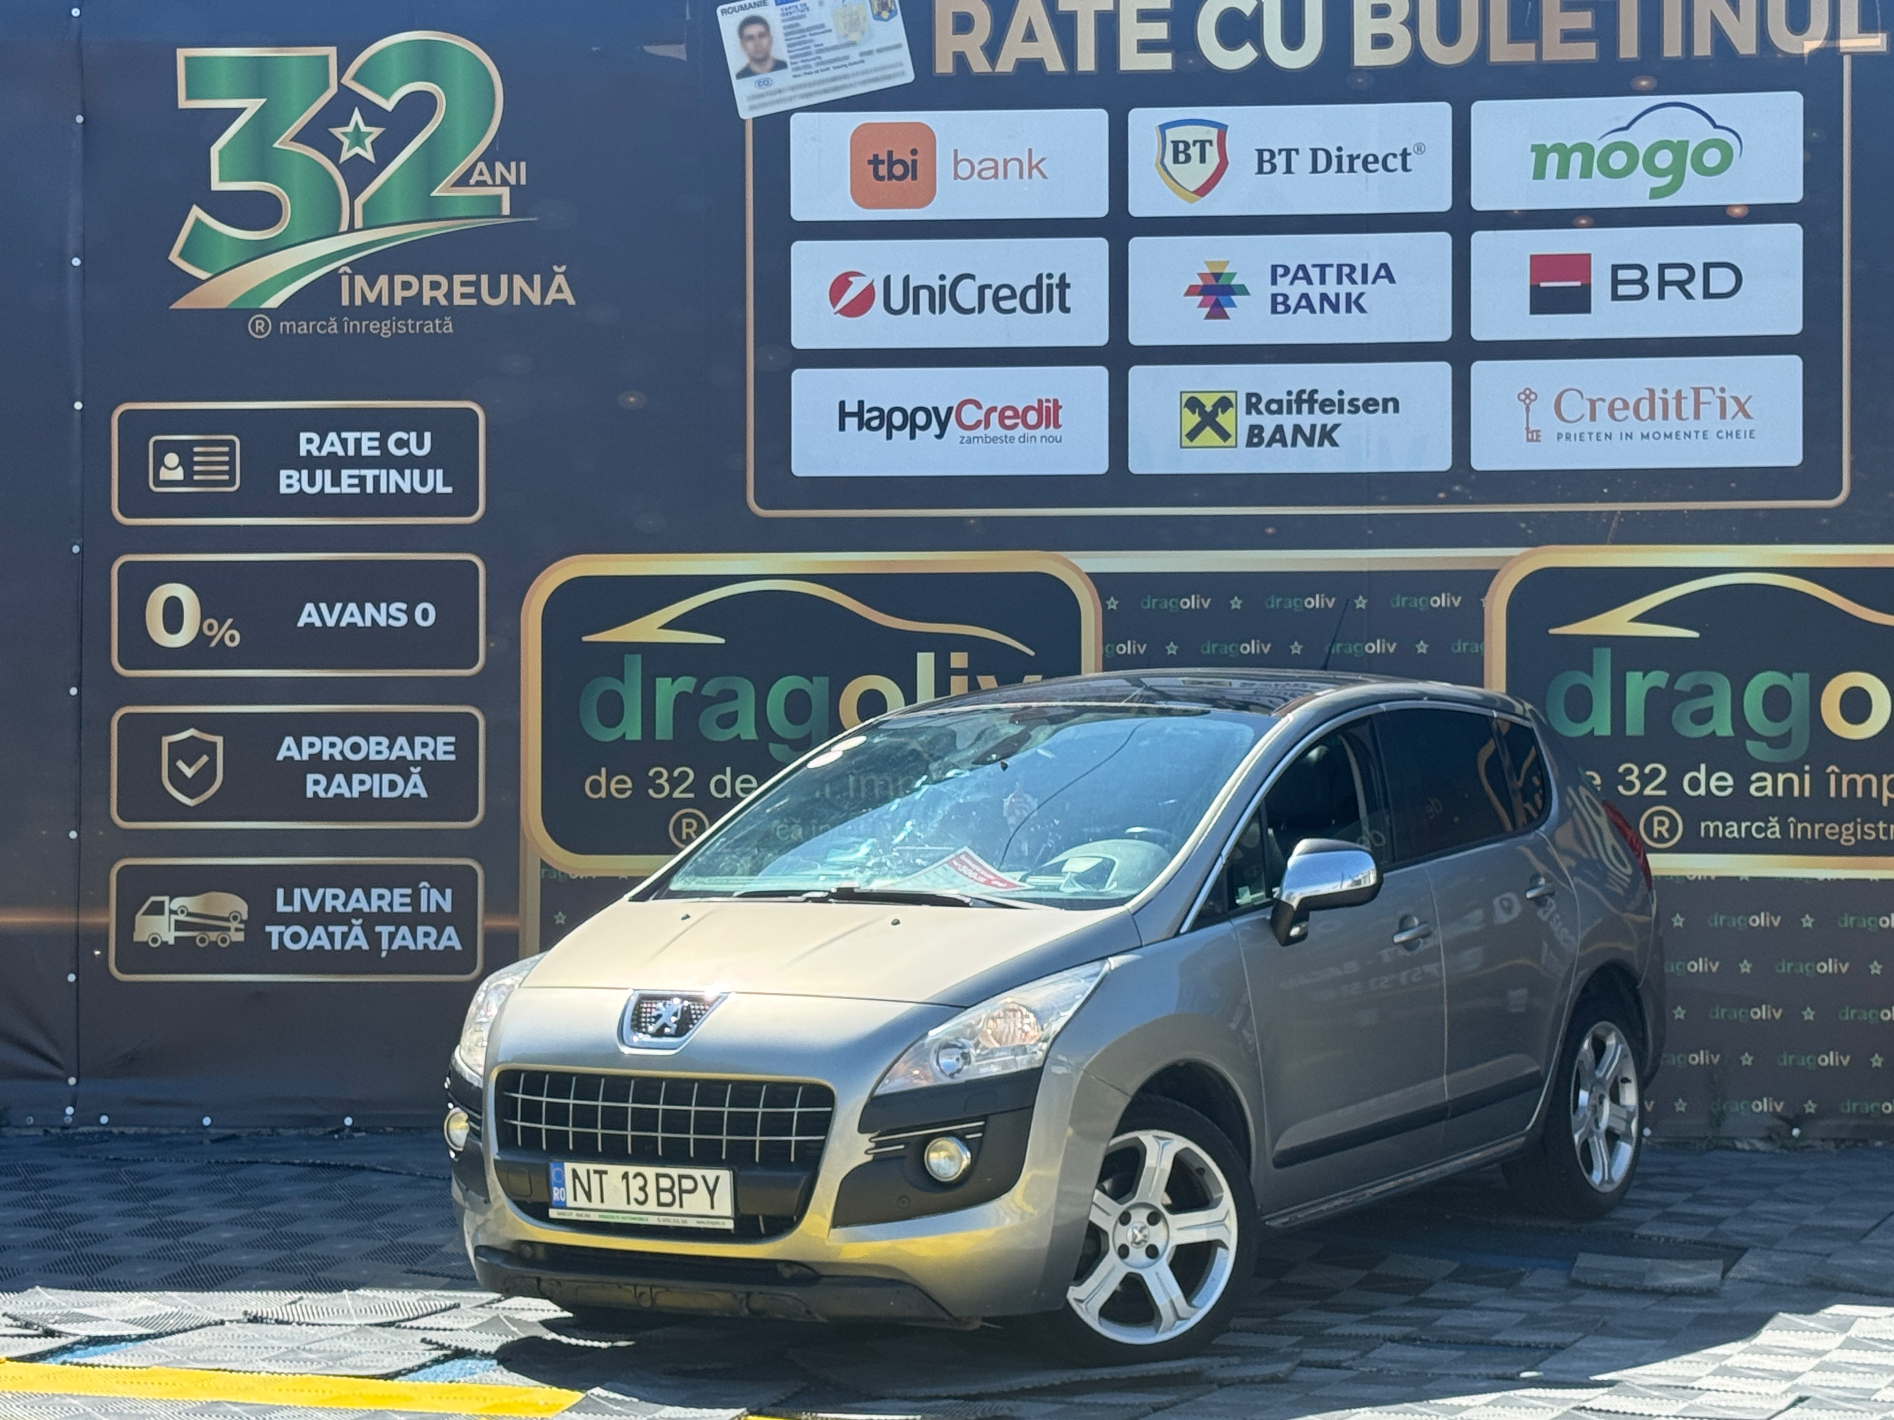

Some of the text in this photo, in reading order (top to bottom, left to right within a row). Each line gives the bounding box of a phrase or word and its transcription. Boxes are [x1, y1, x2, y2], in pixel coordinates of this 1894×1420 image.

[933, 0, 1173, 74] RATE
[1196, 0, 1325, 71] CU
[168, 30, 512, 281] 32
[867, 147, 1049, 182] tbi bank
[1170, 138, 1214, 165] BT
[1254, 147, 1300, 176] BT
[469, 160, 528, 187] ANI
[1529, 137, 1735, 201] mogo
[338, 264, 577, 307] ÎMPREUNĂ
[1269, 262, 1398, 287] PATRIA
[1609, 261, 1744, 302] BRD
[882, 271, 1072, 317] UniCredit
[1269, 291, 1368, 316] BANK
[279, 315, 339, 336] marcă
[343, 316, 455, 338] înregistrată
[1244, 388, 1400, 416] Raiffeisen
[1553, 385, 1755, 424] CreditFix
[837, 397, 1064, 441] HappyCredit
[298, 430, 433, 458] RATE CU
[958, 432, 1063, 446] zambeste din nou
[1244, 422, 1342, 449] BANK
[1556, 428, 1757, 443] PRIETEN IN MOMENTE CHEIE
[278, 468, 454, 495] BULETINUL
[296, 601, 437, 629] AVANS 0
[1140, 594, 1212, 613] dragoliv
[1264, 593, 1336, 612] dragoliv
[1390, 592, 1463, 611] dragoliv
[1200, 638, 1273, 658] dragoliv
[578, 651, 1043, 764] dragoli
[275, 735, 457, 762] APROBARE
[305, 766, 429, 799] RAPIDĂ
[584, 766, 758, 799] de 32 de
[1617, 762, 1668, 797] 32
[1682, 763, 1735, 798] de
[1748, 764, 1811, 798] ani
[1699, 816, 1782, 840] marcă
[275, 881, 453, 914] LIVRARE ÎN
[1707, 911, 1782, 931] dragoliv
[265, 919, 463, 959] TOATĂ ȚARA
[1774, 957, 1850, 977] dragoliv
[1708, 1004, 1783, 1023] dragoliv
[1776, 1050, 1851, 1070] dragoliv
[552, 1186, 566, 1202] RO
[571, 1167, 721, 1210] NT 13 BPY
